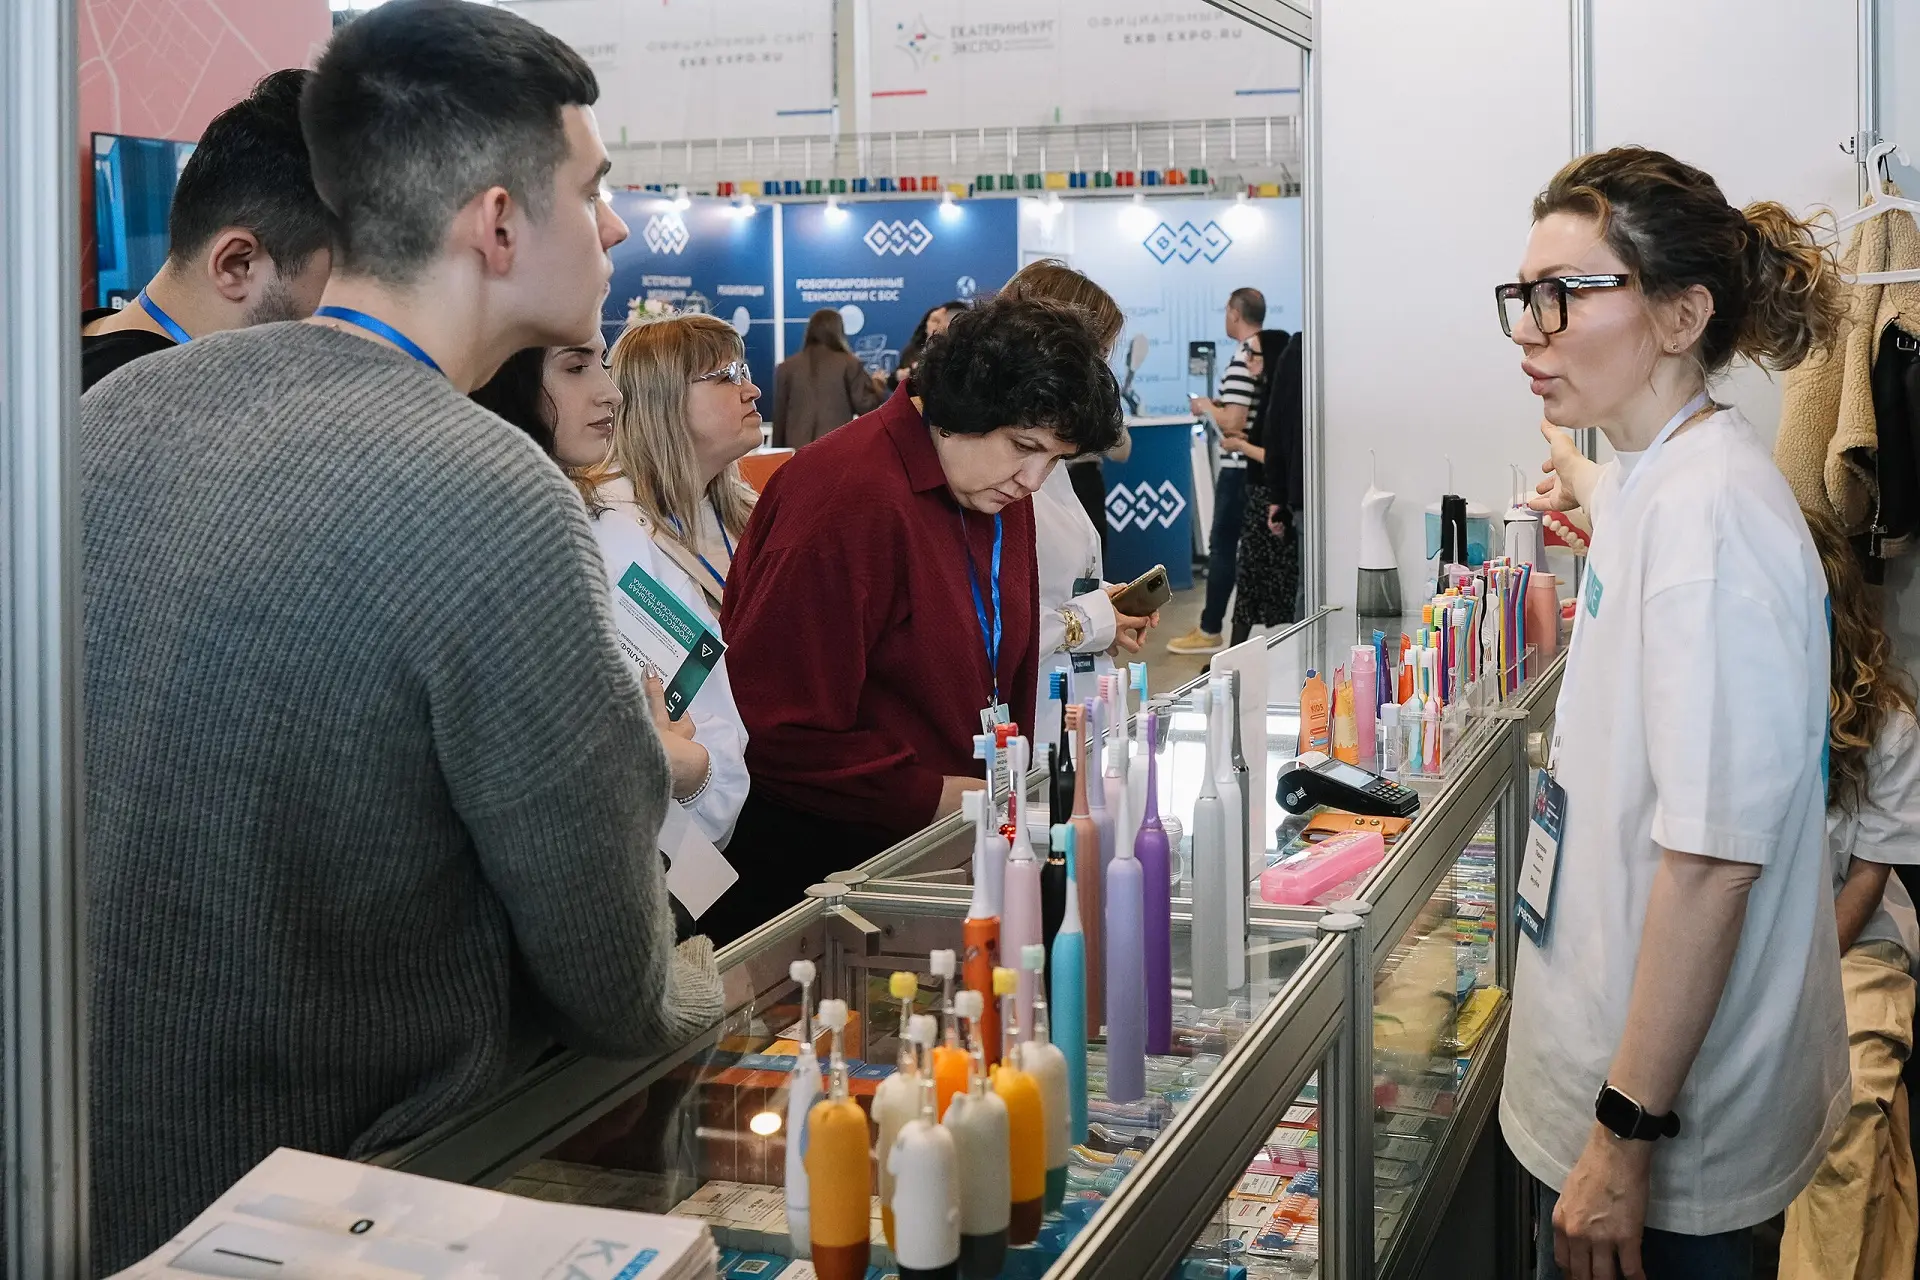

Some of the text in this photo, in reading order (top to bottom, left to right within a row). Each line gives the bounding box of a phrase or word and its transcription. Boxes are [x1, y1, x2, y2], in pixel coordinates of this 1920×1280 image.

[950, 20, 1055, 39] ЕКАТЕРИНБУРГ
[952, 40, 1003, 55] ЭКСПО
[632, 577, 658, 602] ТЕХНИКА
[627, 582, 693, 644] ПРОФЕССИОНАЛЬНАЯ
[1310, 703, 1324, 713] KIDS
